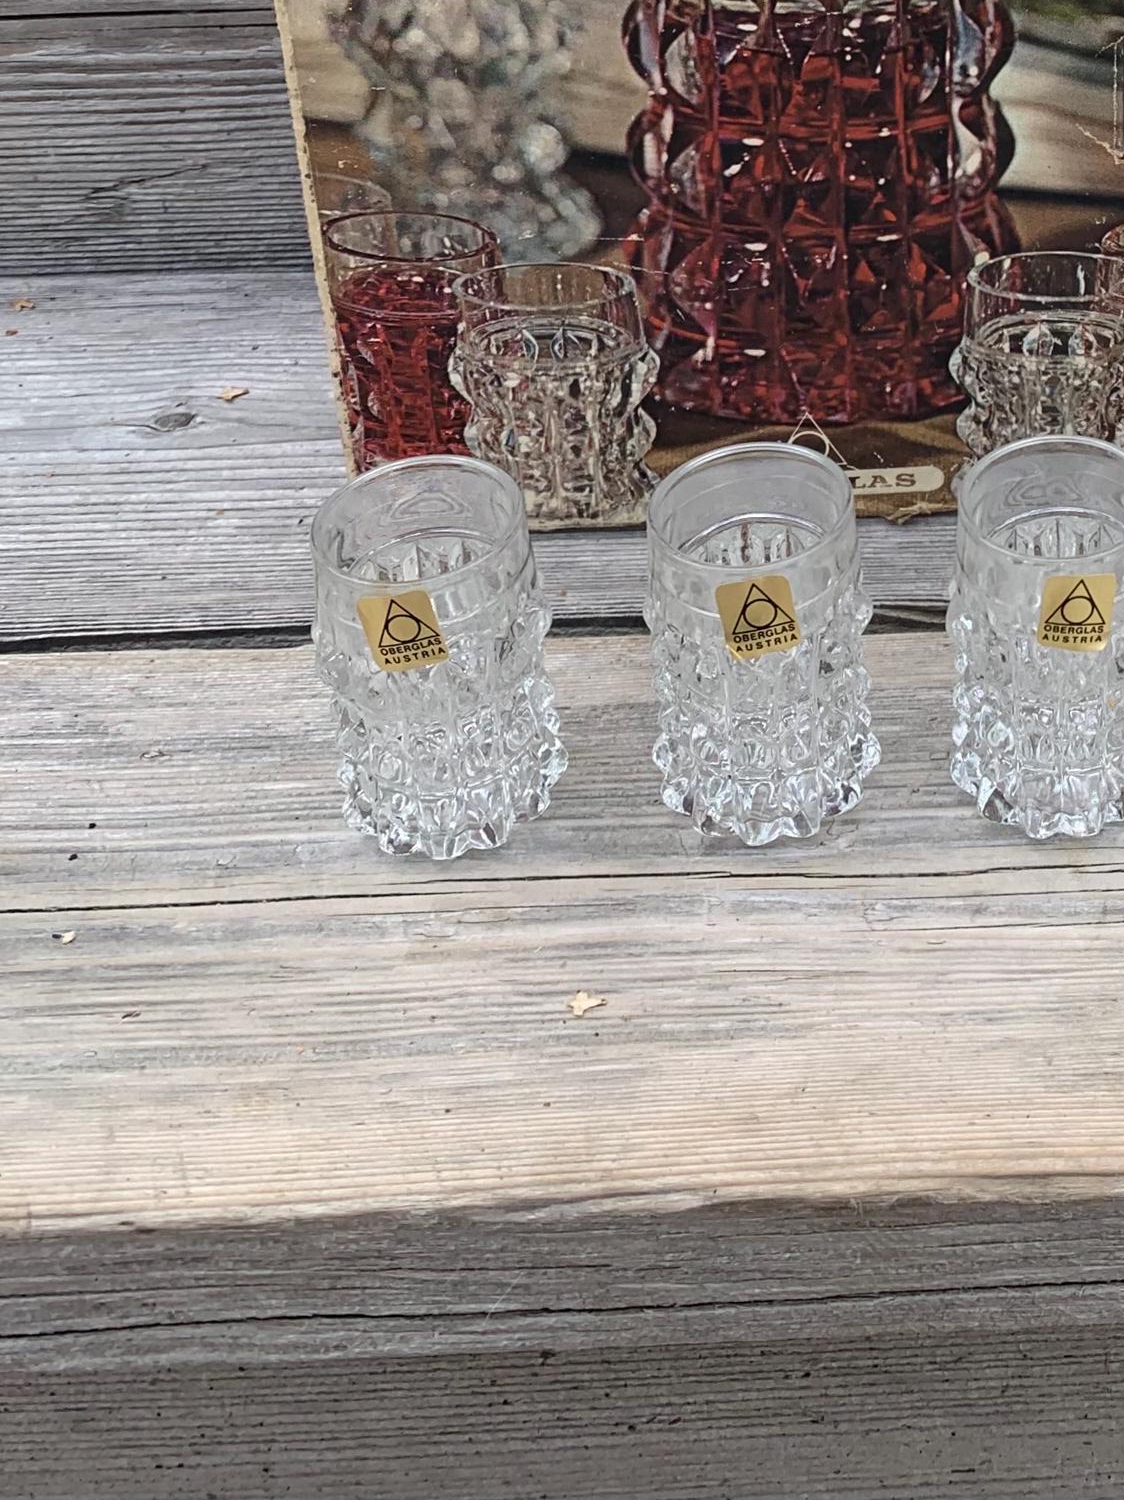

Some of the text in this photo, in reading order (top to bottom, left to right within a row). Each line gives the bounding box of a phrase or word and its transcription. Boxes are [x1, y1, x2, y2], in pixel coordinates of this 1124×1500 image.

[848, 473, 917, 490] LAS
[733, 623, 796, 644] OBERGLAS
[1041, 634, 1103, 644] AUSTRIA
[1043, 624, 1105, 635] OBERGLAS
[380, 637, 442, 656] OBERGLAS
[736, 633, 799, 653] AUSTRIA
[384, 646, 446, 665] AUSTRIA
